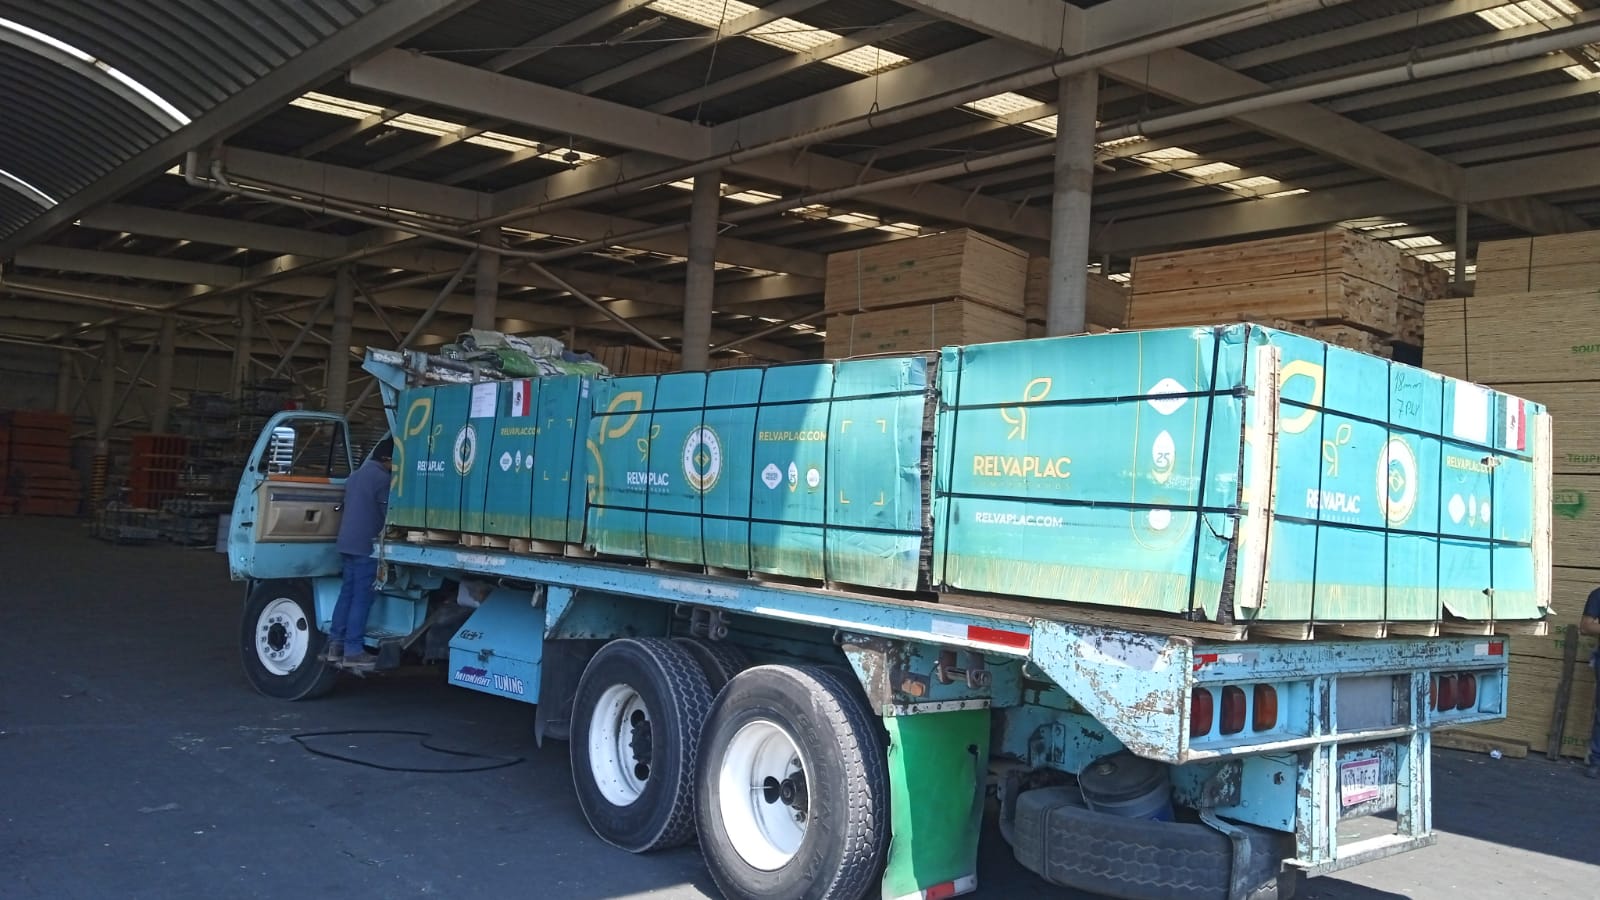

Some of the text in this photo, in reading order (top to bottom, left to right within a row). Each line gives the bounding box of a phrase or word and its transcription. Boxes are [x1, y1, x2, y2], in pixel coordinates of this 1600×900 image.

[973, 455, 1072, 478] RELVAPLAC
[626, 471, 670, 486] RELVAPLAC
[975, 511, 1064, 528] RELVAPLAC.COM
[454, 670, 524, 695] MIDNIGHT TUNING
